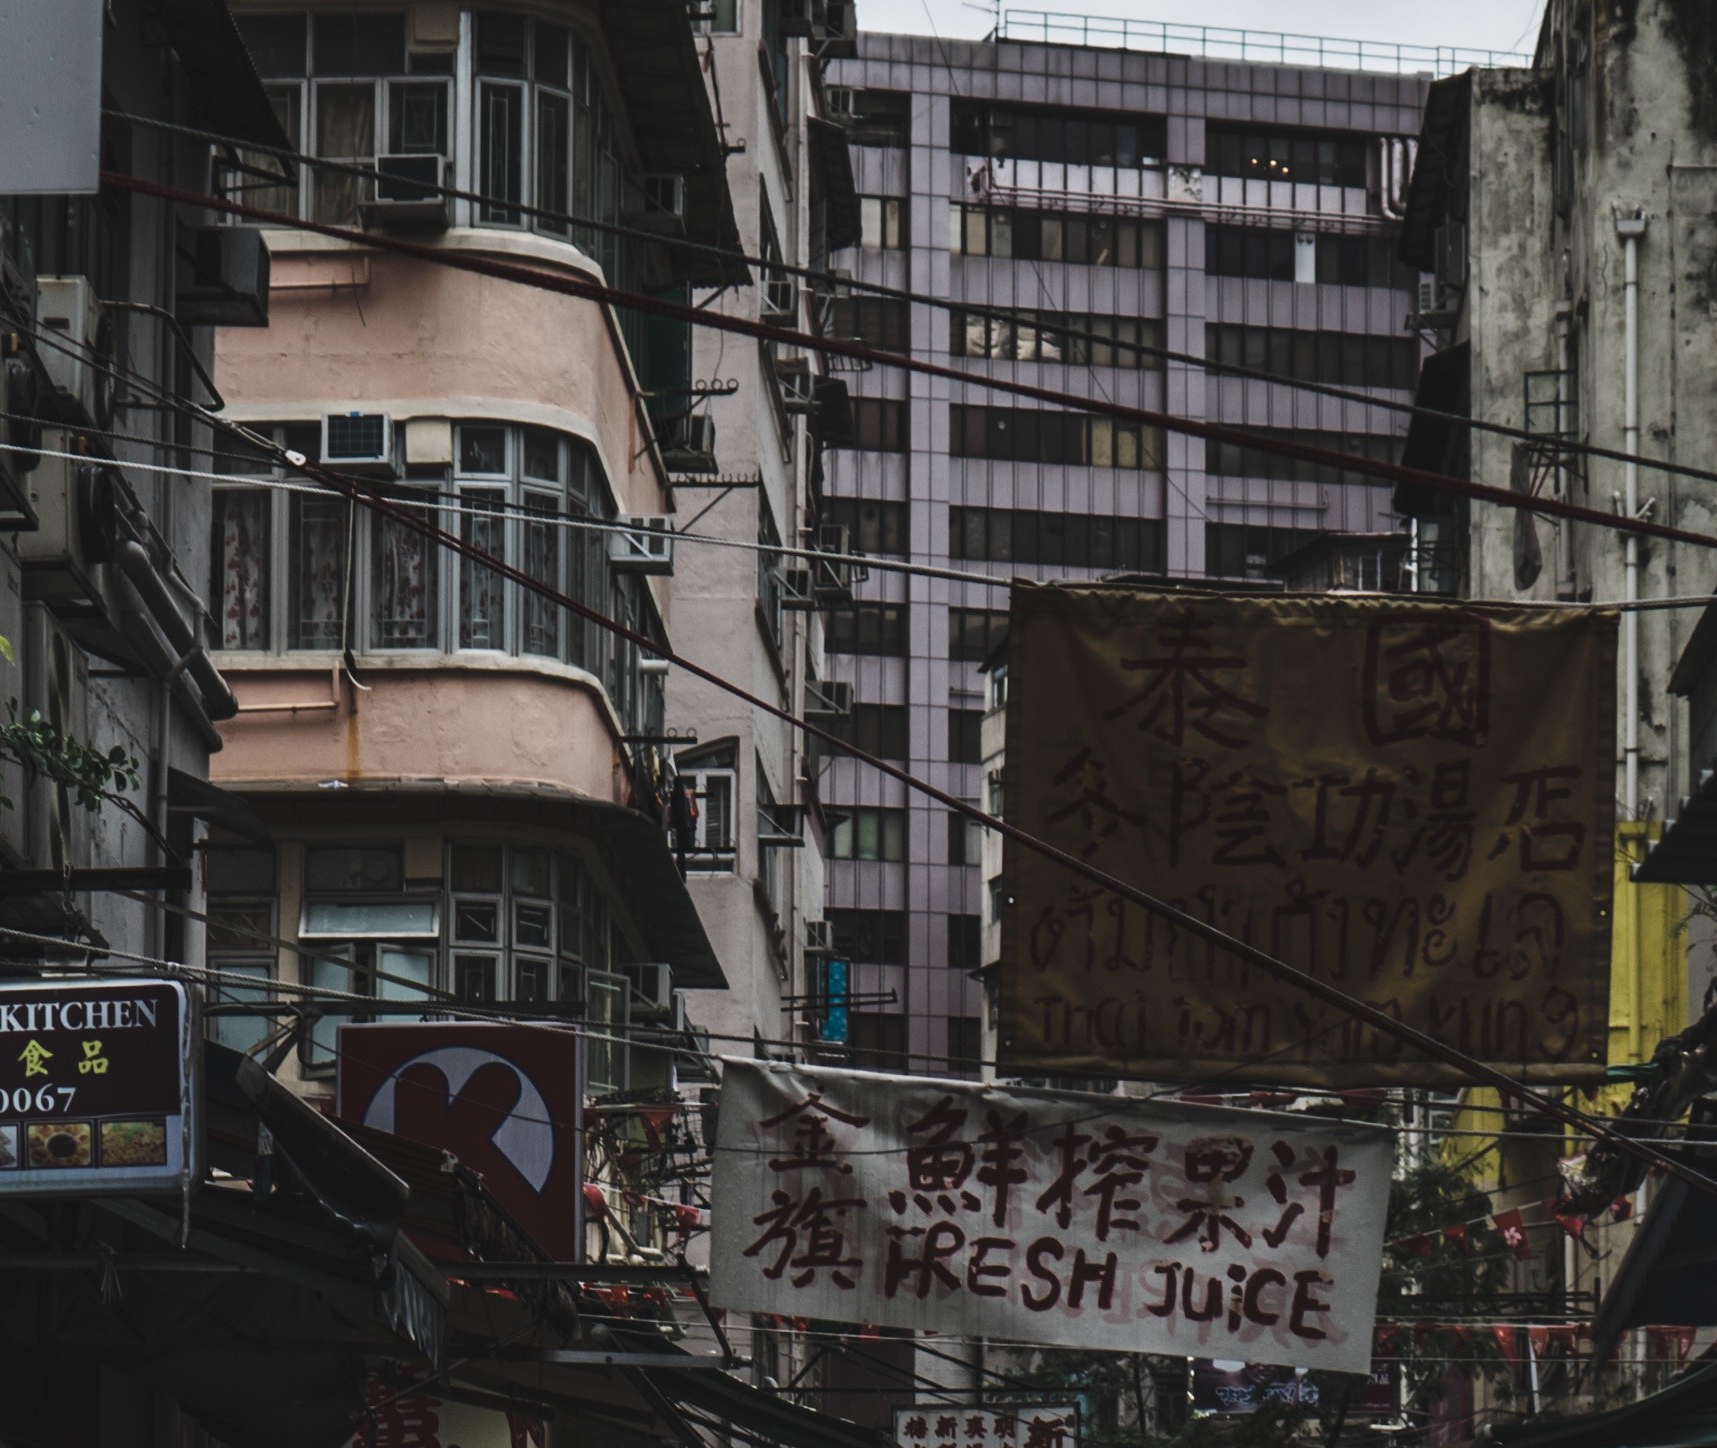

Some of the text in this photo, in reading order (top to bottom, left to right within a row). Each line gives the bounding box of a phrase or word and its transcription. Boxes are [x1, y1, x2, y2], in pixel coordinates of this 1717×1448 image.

[1104, 603, 1490, 749] 泰國
[743, 1084, 872, 1290] 金旗
[885, 1222, 1118, 1314] FRESH
